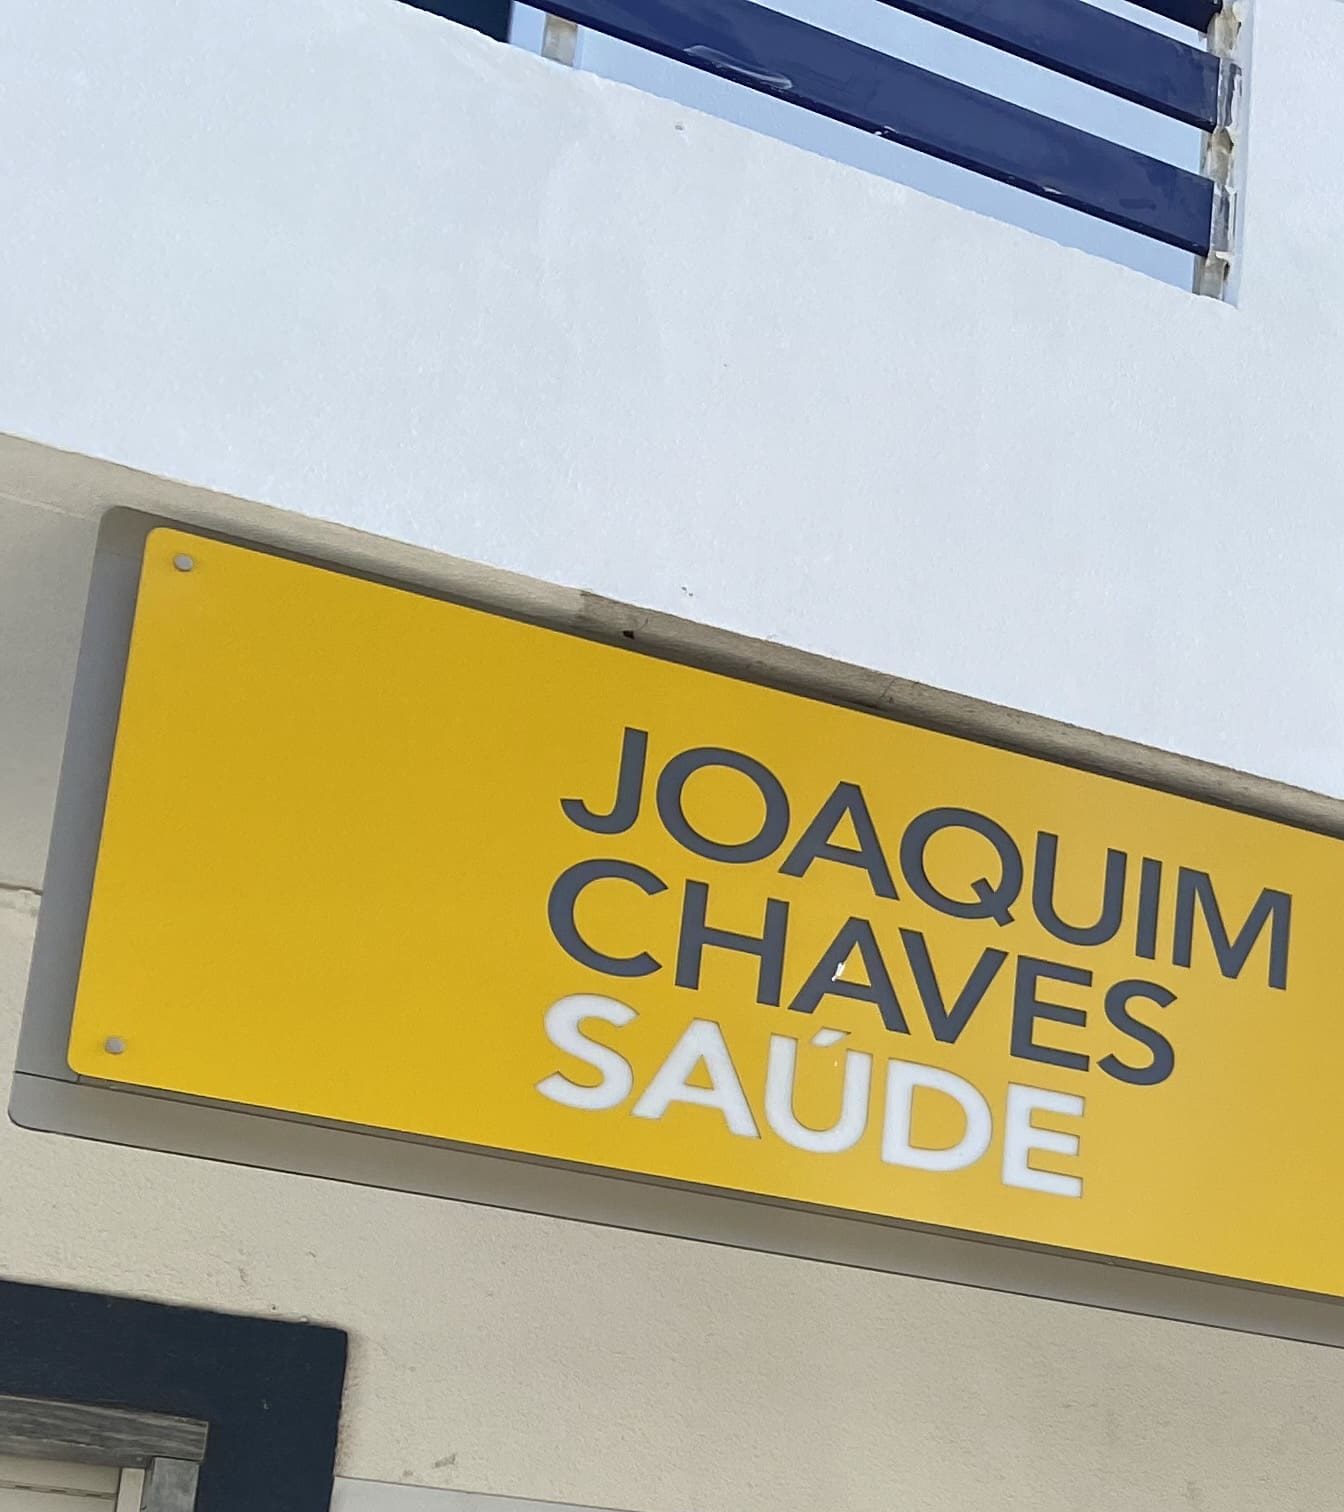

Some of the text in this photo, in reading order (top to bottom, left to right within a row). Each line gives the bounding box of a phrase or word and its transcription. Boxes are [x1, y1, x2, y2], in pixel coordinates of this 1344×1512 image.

[560, 726, 1293, 990] JOAQUIM
[547, 859, 1177, 1086] CHAVES
[535, 993, 1086, 1198] SAÚDE
